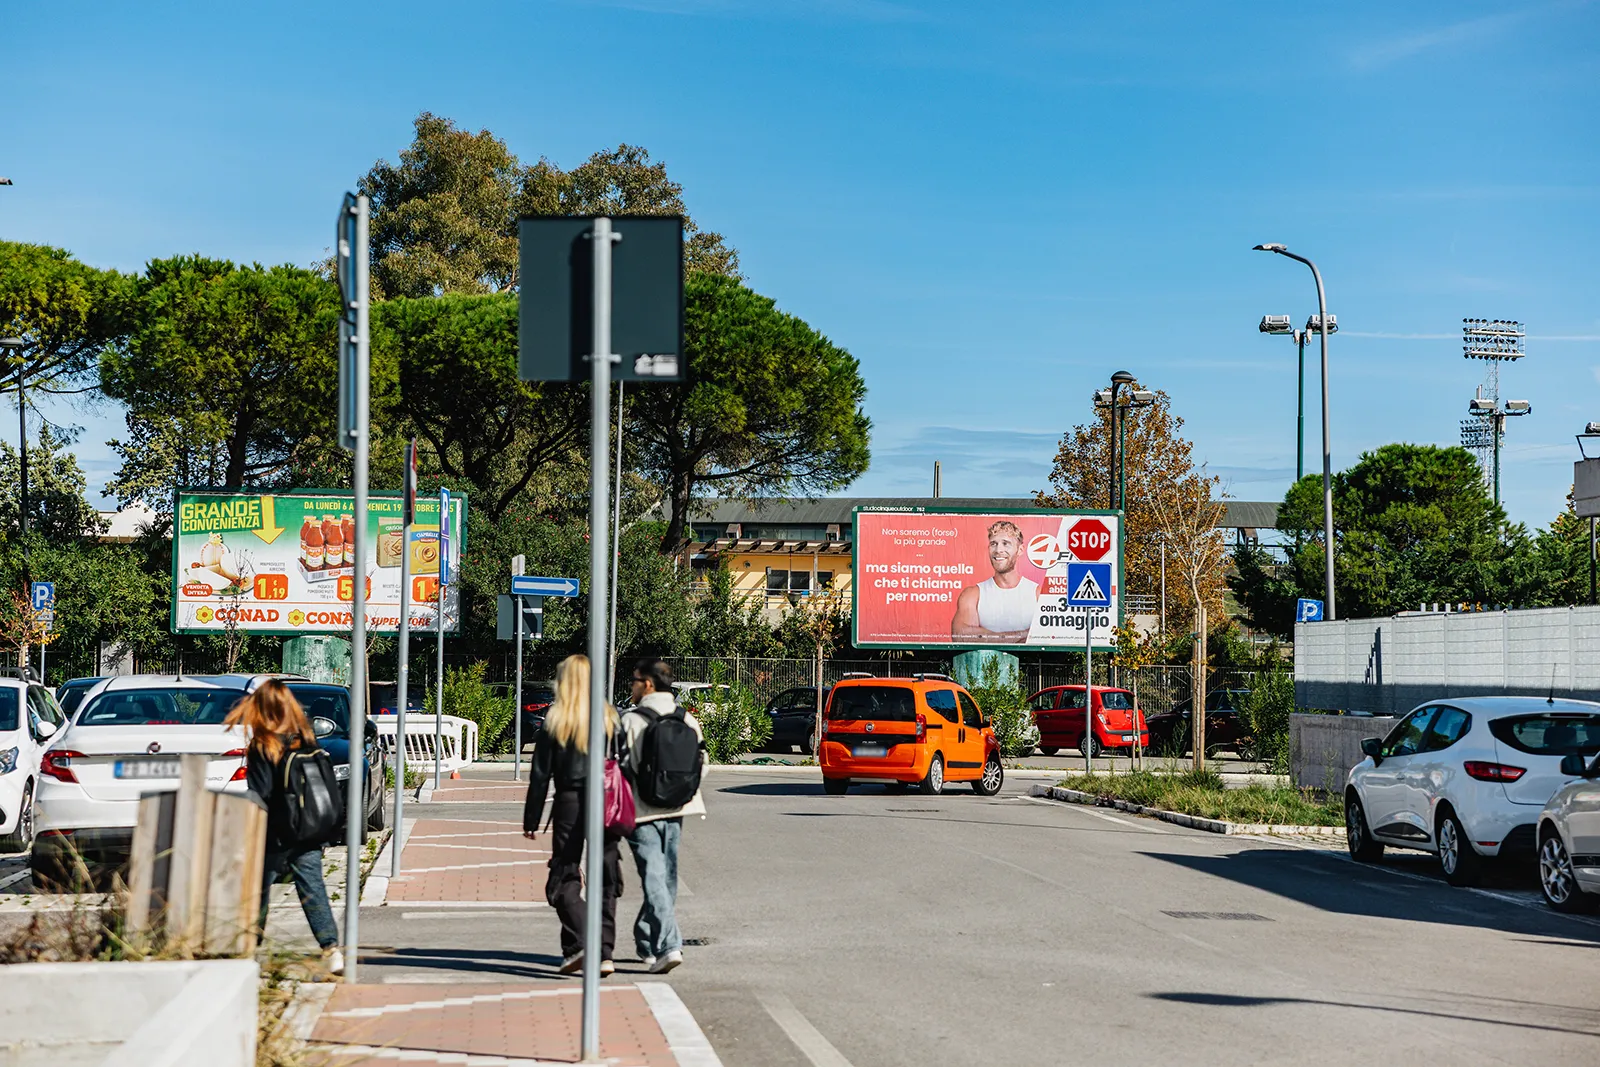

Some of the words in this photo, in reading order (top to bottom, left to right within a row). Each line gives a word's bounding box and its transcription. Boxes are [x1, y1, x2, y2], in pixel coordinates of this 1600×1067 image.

[181, 500, 260, 519] GRANDE
[304, 502, 314, 510] DA
[315, 500, 340, 510] LUNEDÌ
[342, 502, 347, 510] 6
[349, 503, 354, 511] A
[366, 503, 391, 511] MENICA
[393, 504, 402, 512] 19
[182, 515, 260, 531] CONVENIENZA
[882, 528, 898, 536] Non
[931, 527, 958, 538] (forse)
[903, 537, 916, 546] più
[917, 538, 946, 547] grande
[1070, 531, 1109, 549] STOP
[866, 563, 888, 573] ma
[890, 562, 930, 574] siamo
[933, 564, 973, 577] quella
[874, 577, 898, 588] che
[901, 577, 910, 588] ti
[911, 577, 961, 589] chiama
[36, 586, 49, 607] P
[886, 592, 908, 604] per
[910, 592, 953, 602] nome!
[1058, 598, 1067, 612] 3
[1302, 602, 1317, 621] P
[215, 608, 279, 622] CONAD
[306, 612, 368, 624] CONA
